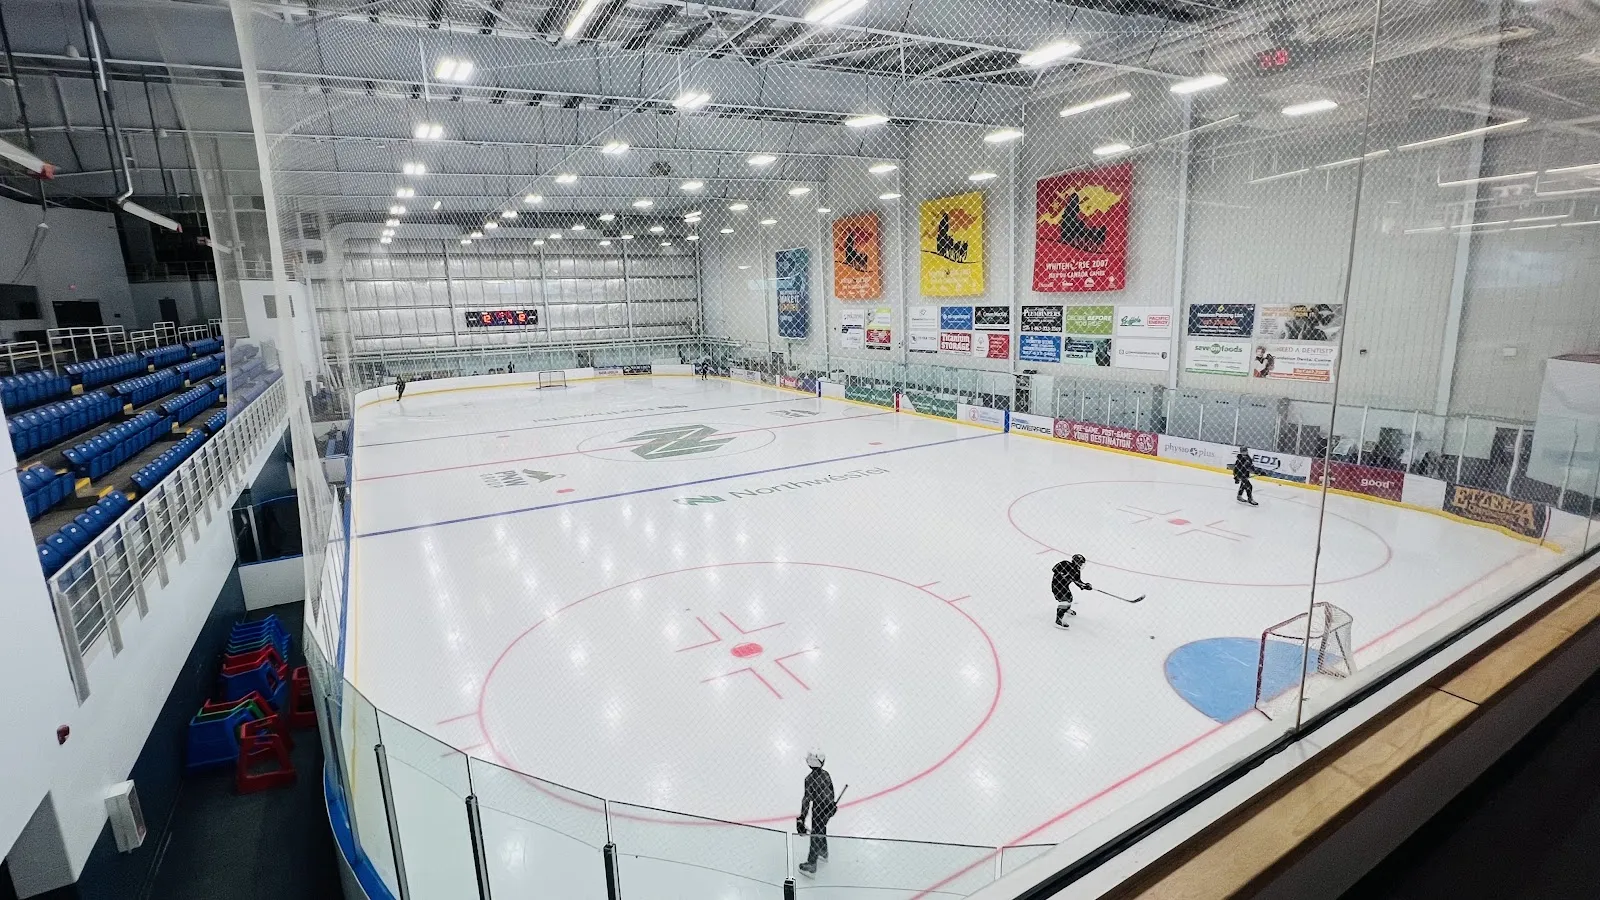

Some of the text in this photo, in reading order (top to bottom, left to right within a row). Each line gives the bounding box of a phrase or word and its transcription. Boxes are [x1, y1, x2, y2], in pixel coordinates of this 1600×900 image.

[1092, 258, 1108, 268] 2007
[942, 333, 970, 342] Titanium
[941, 342, 970, 351] STORAGE
[1074, 432, 1089, 442] YOUR
[1165, 442, 1215, 457] physio plus
[1253, 454, 1278, 466] EDI
[1360, 479, 1390, 489] good
